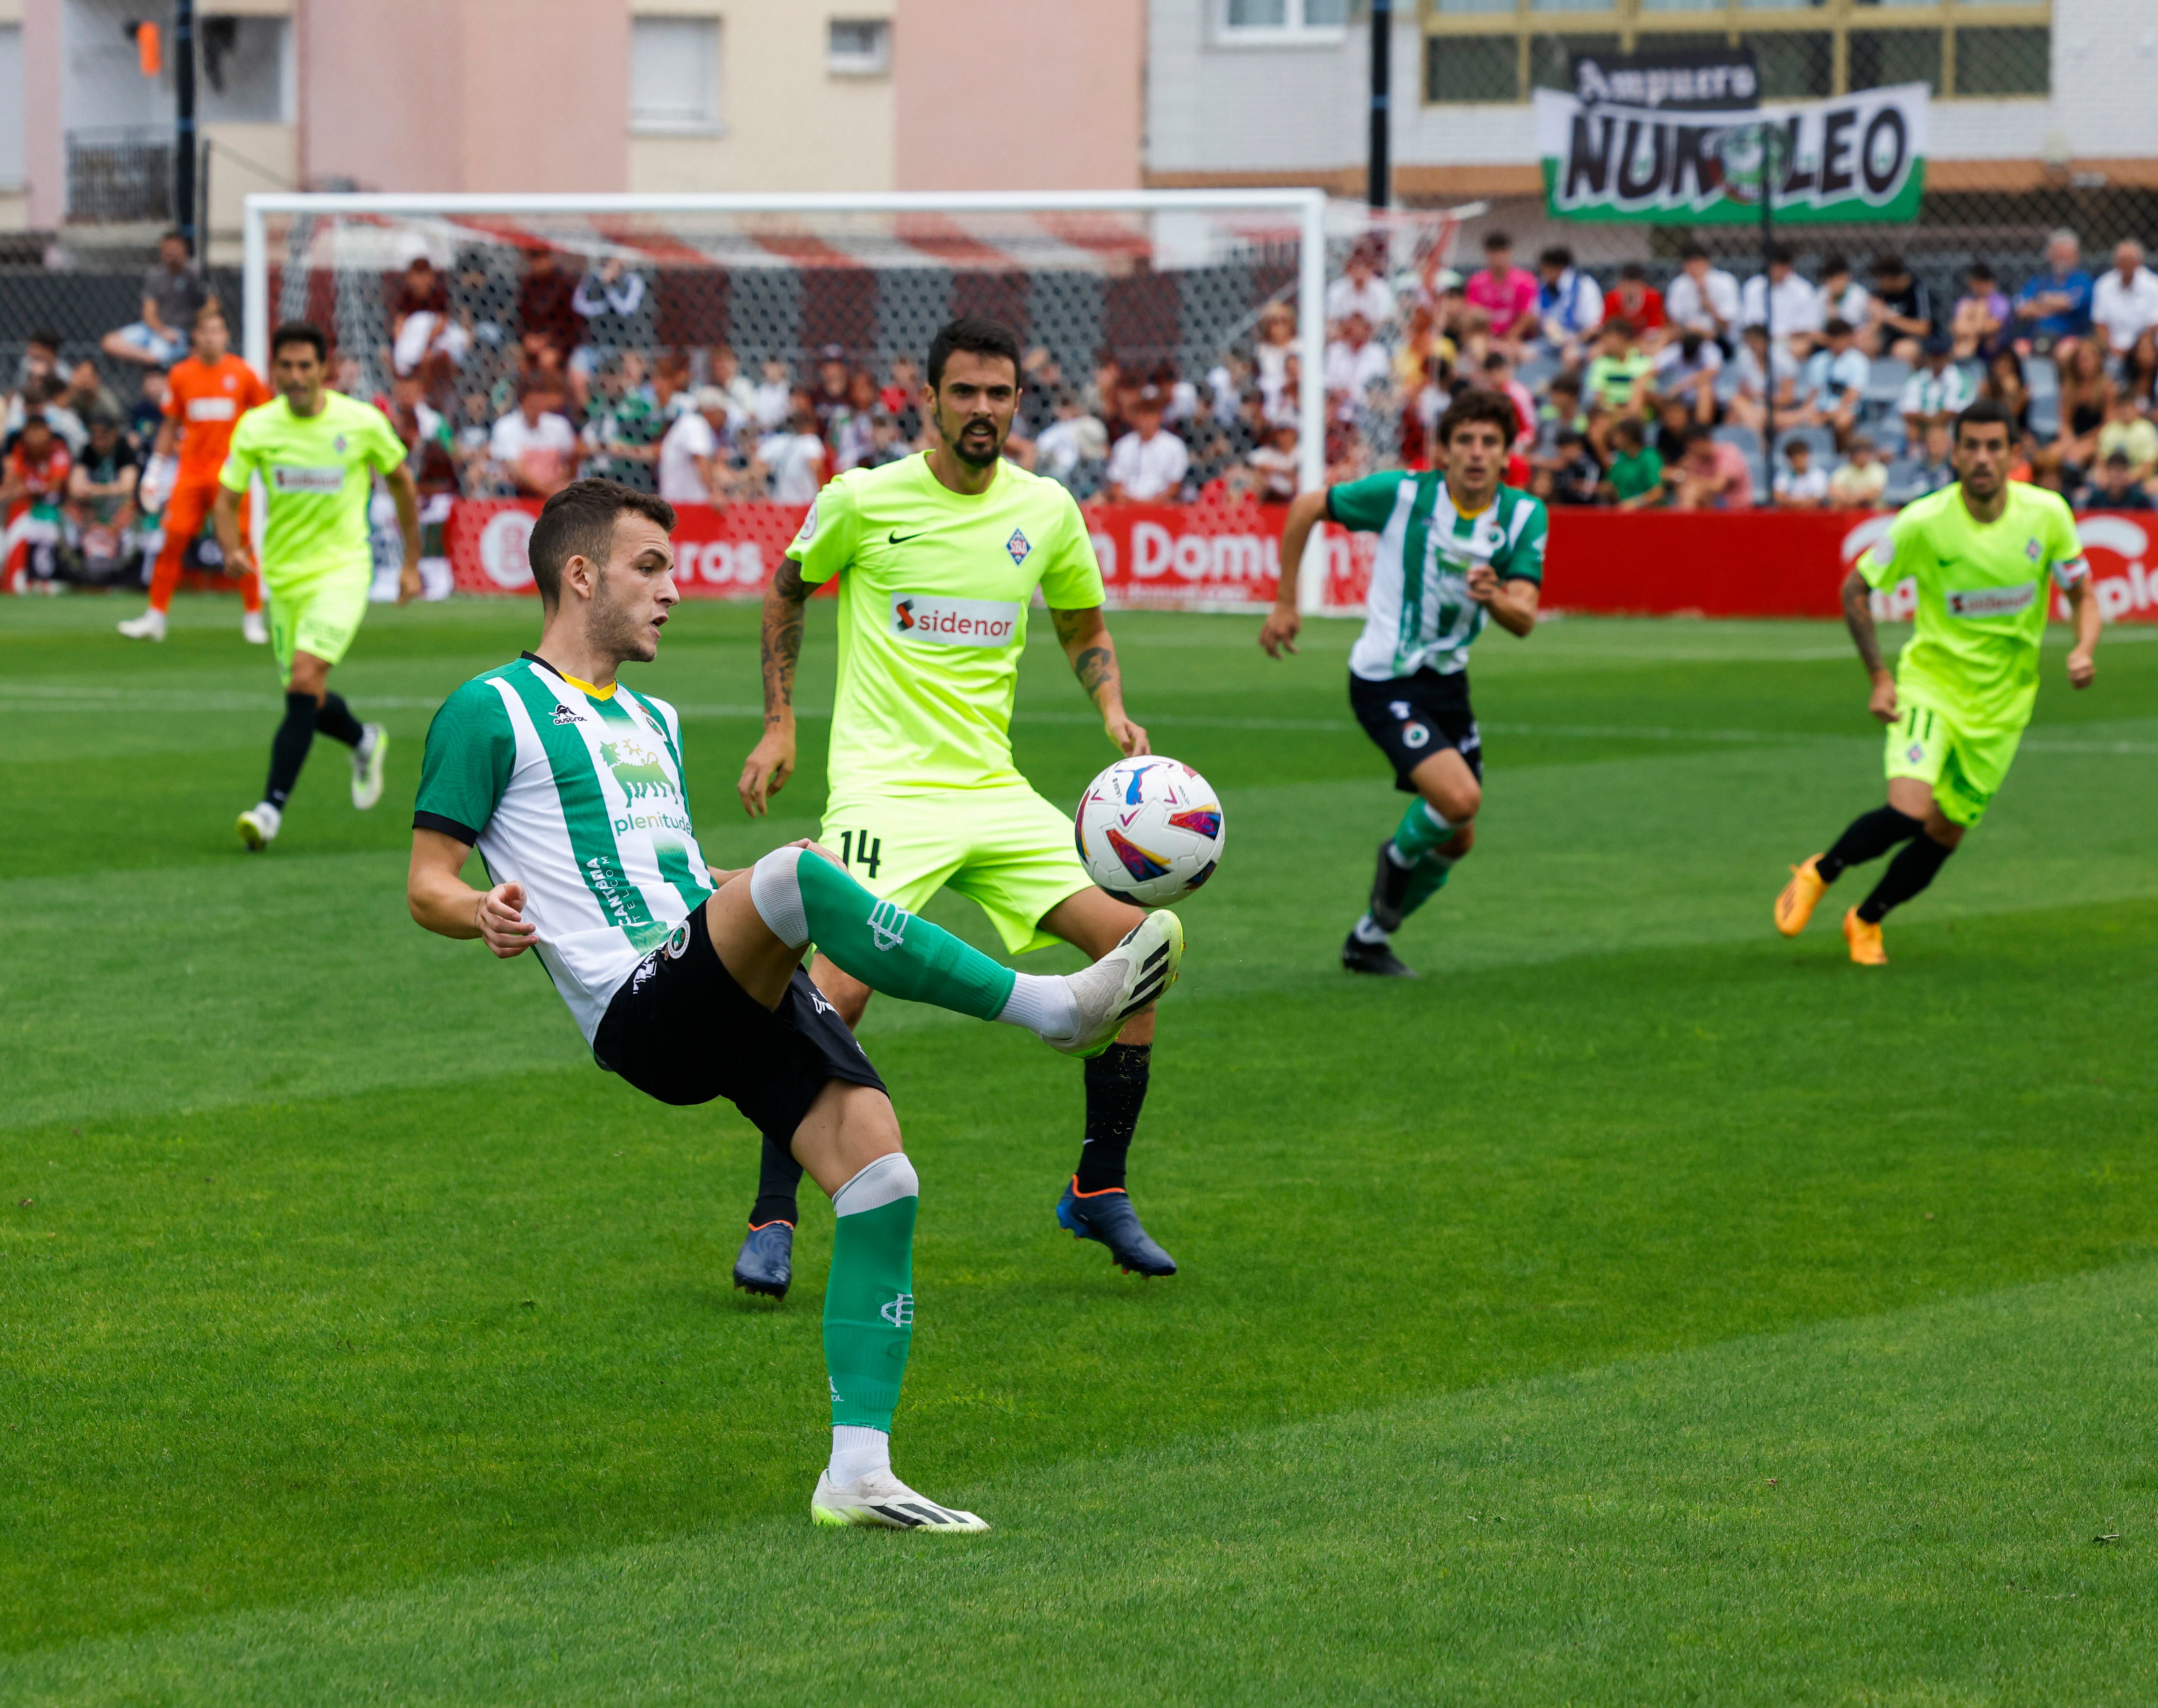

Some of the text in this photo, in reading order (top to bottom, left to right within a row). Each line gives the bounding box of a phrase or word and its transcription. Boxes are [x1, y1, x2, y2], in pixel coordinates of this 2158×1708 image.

[671, 542, 764, 584] ros
[919, 610, 1013, 637] sidenor
[1907, 708, 1933, 740] 11
[614, 811, 692, 837] plenitude
[841, 830, 881, 879] 14
